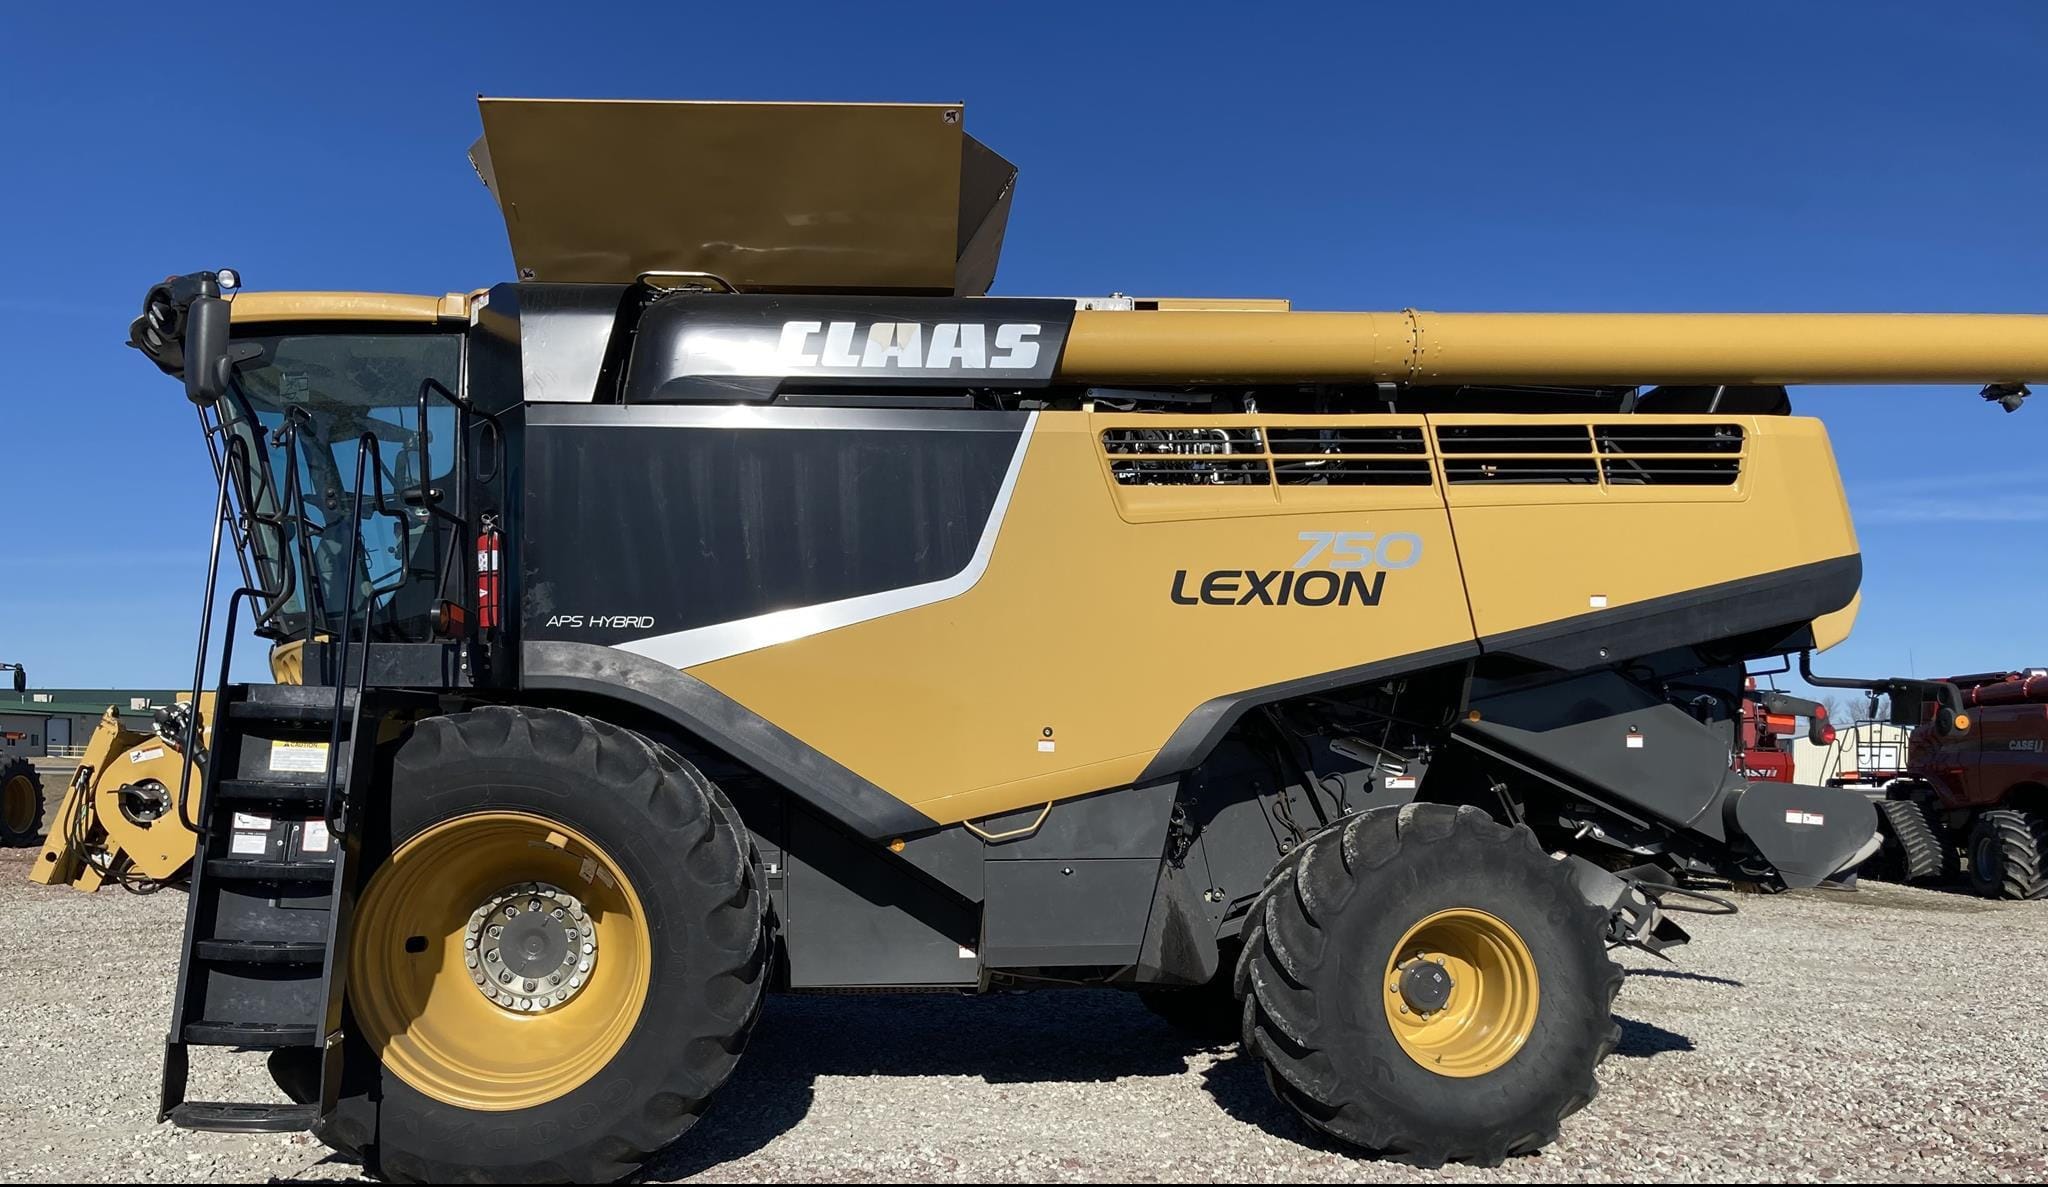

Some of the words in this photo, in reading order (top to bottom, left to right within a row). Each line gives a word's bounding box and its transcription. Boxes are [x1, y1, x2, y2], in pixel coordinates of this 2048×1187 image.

[777, 321, 1042, 369] CLAAS
[1293, 531, 1424, 569] 750
[1170, 570, 1387, 607] LEXION
[545, 615, 584, 628] APS
[588, 615, 655, 629] HYBRID
[2009, 740, 2035, 750] CASE
